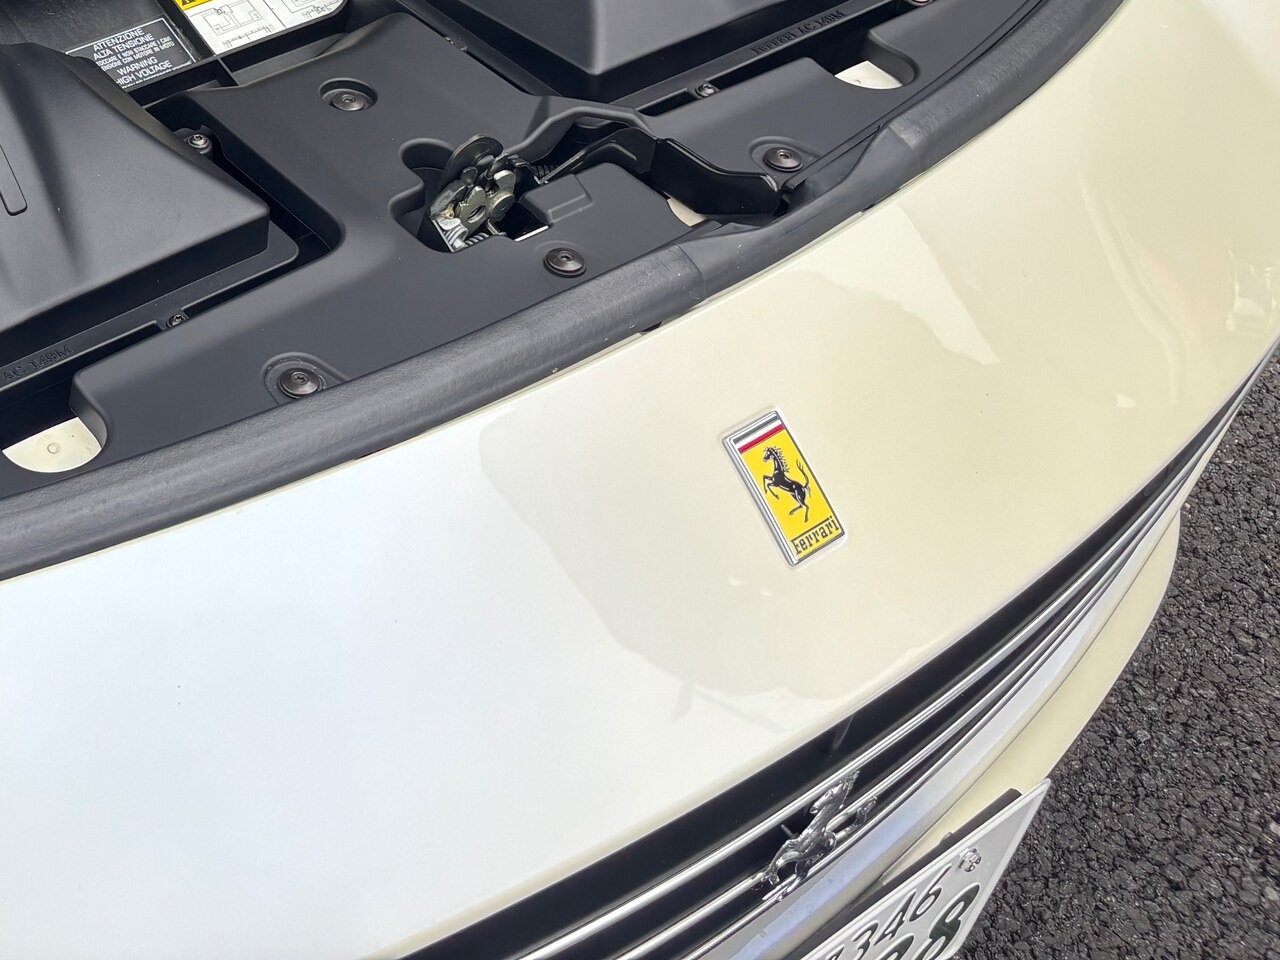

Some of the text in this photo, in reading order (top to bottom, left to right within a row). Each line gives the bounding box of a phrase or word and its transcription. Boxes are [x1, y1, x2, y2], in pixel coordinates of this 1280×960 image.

[93, 28, 144, 52] ATTENZIONE
[93, 33, 155, 61] ALTA TENSIONE
[133, 41, 157, 54] STACCARE
[133, 48, 155, 62] MOTORE
[117, 56, 158, 76] WARNING
[136, 60, 173, 79] VOLTAGE
[791, 515, 839, 555] Ferrari
